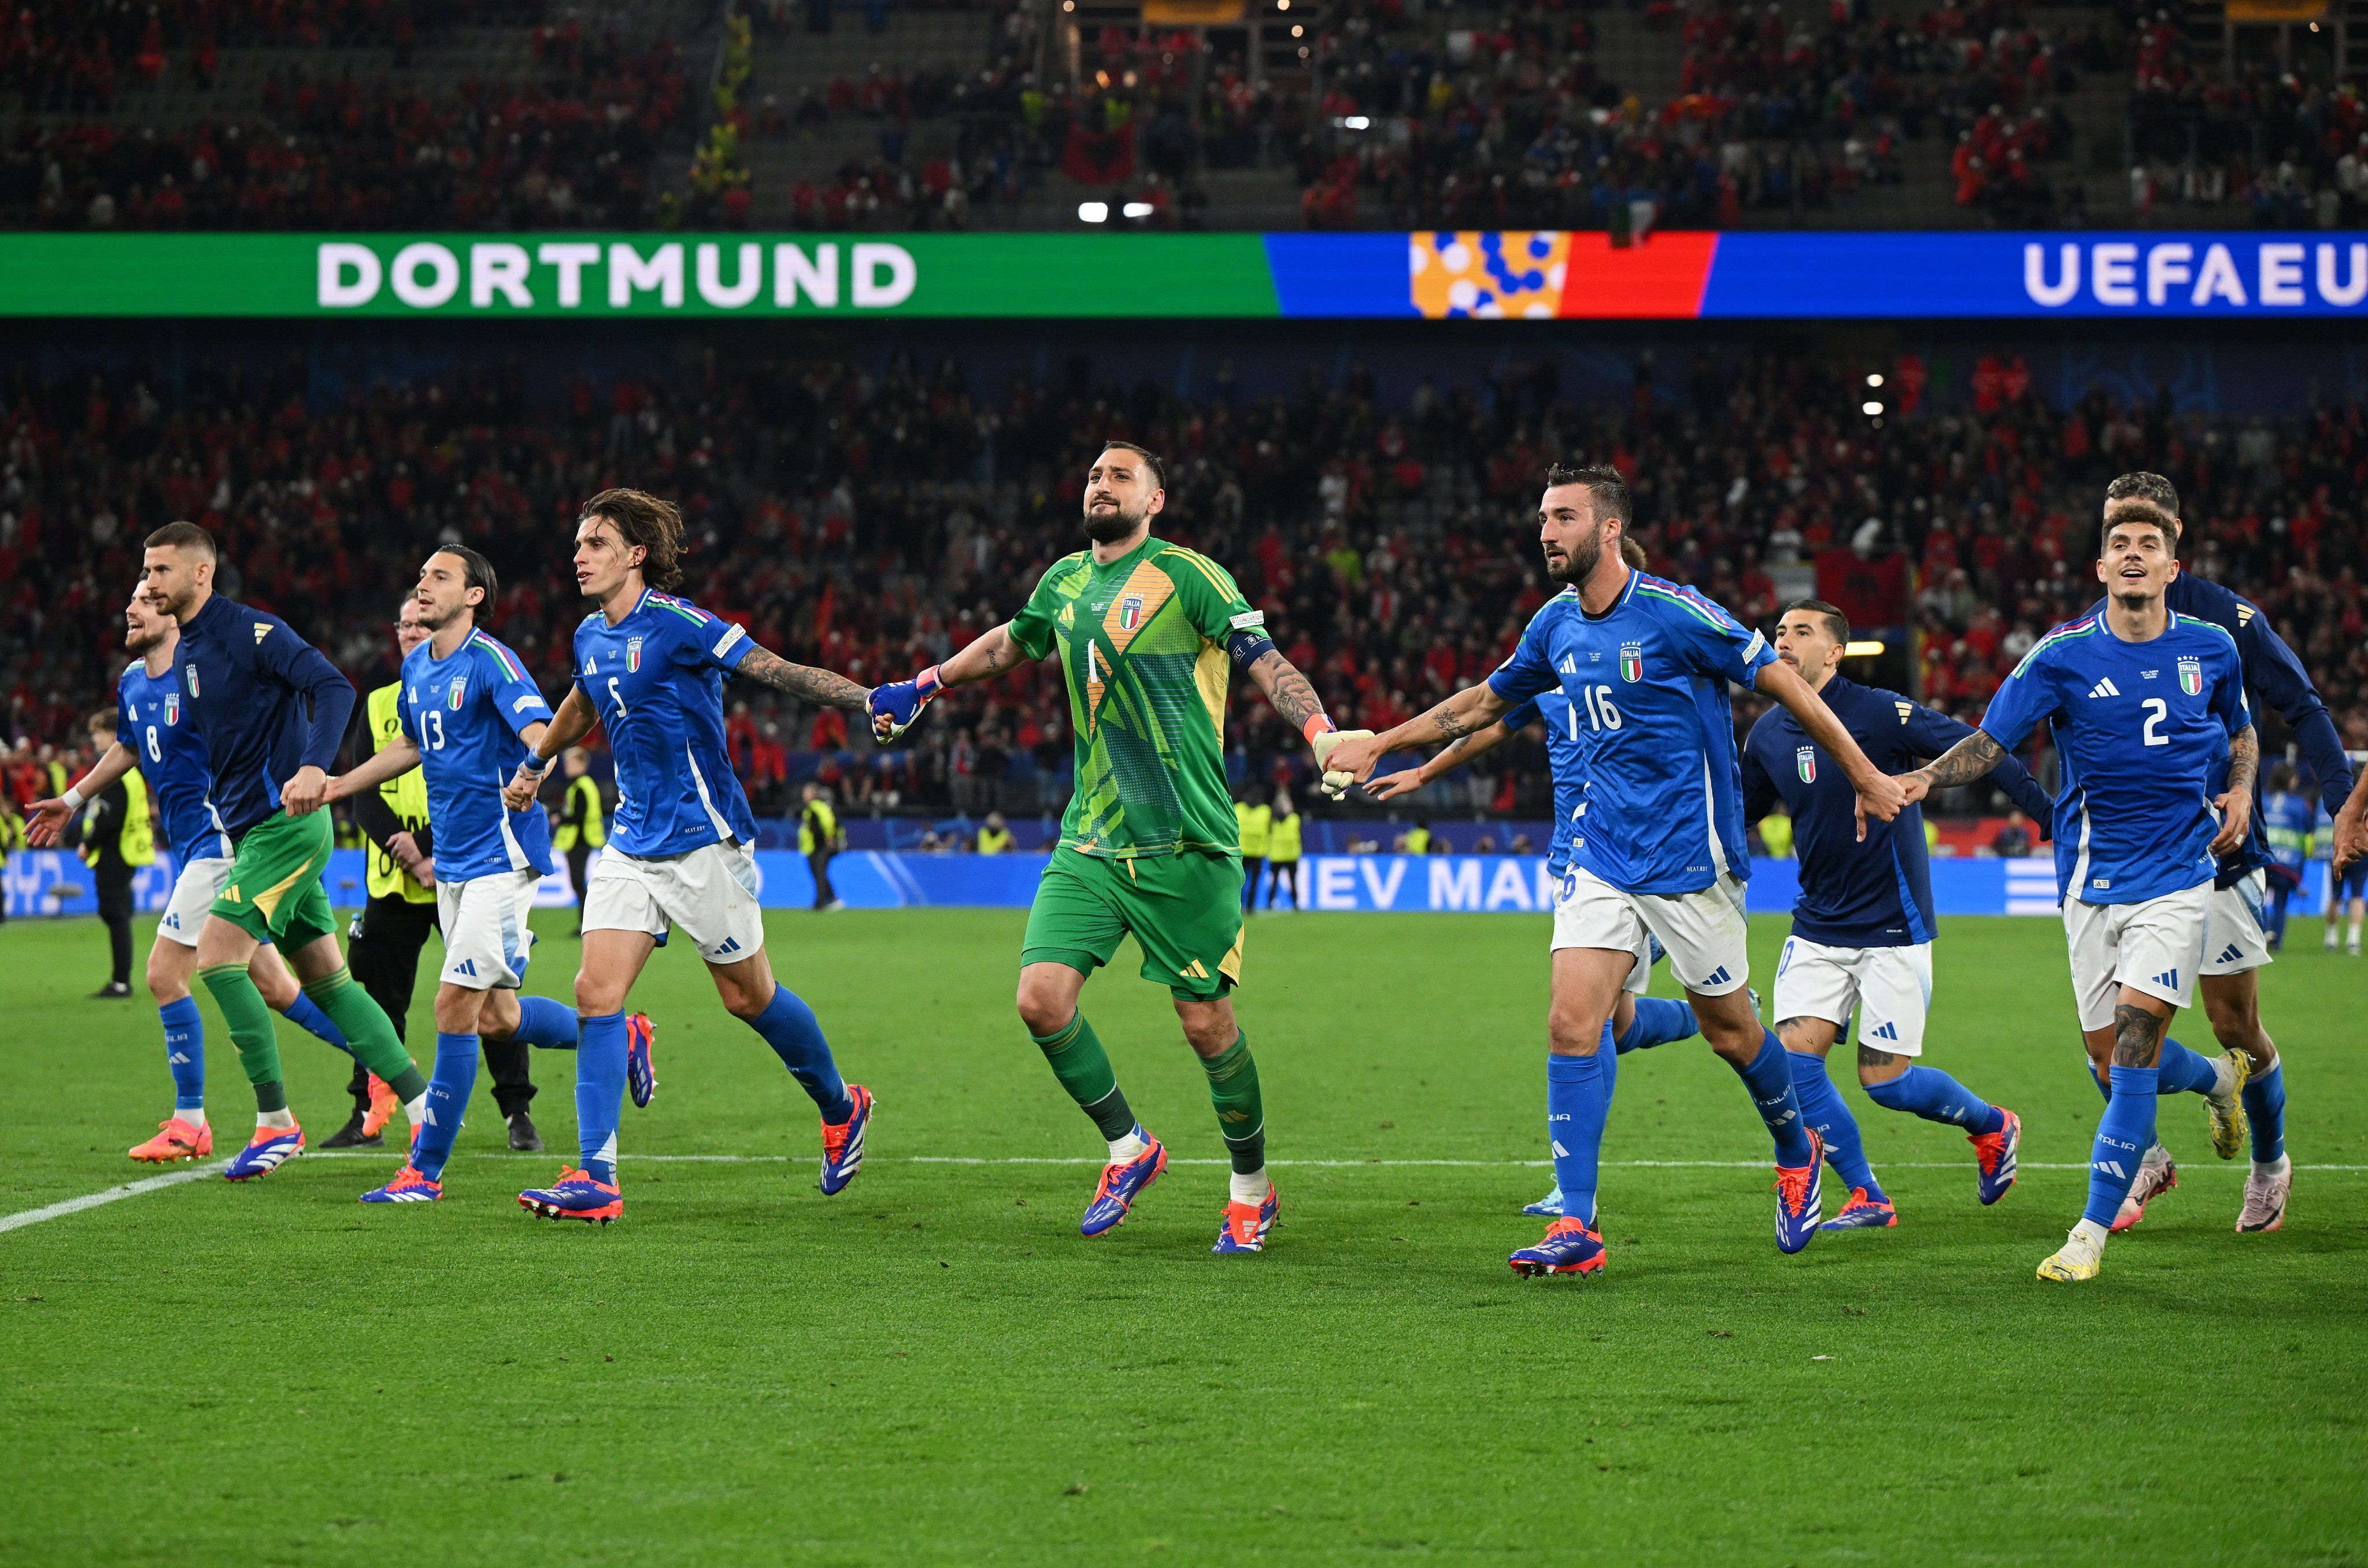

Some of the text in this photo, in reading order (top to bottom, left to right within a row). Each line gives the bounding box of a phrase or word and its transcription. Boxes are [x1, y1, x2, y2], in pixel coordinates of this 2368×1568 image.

[317, 241, 918, 308] DORTMUND
[1124, 599, 1140, 607] ITALIA
[1232, 614, 1263, 624] FOUNDATION
[715, 626, 742, 655] FOUNDATION
[1087, 638, 1098, 683] 1
[608, 677, 627, 718] 5
[1585, 685, 1622, 731] 16
[420, 710, 445, 751] 13
[2141, 698, 2169, 746] 2
[146, 725, 161, 763] 8
[684, 825, 706, 834] HEAT.RDY
